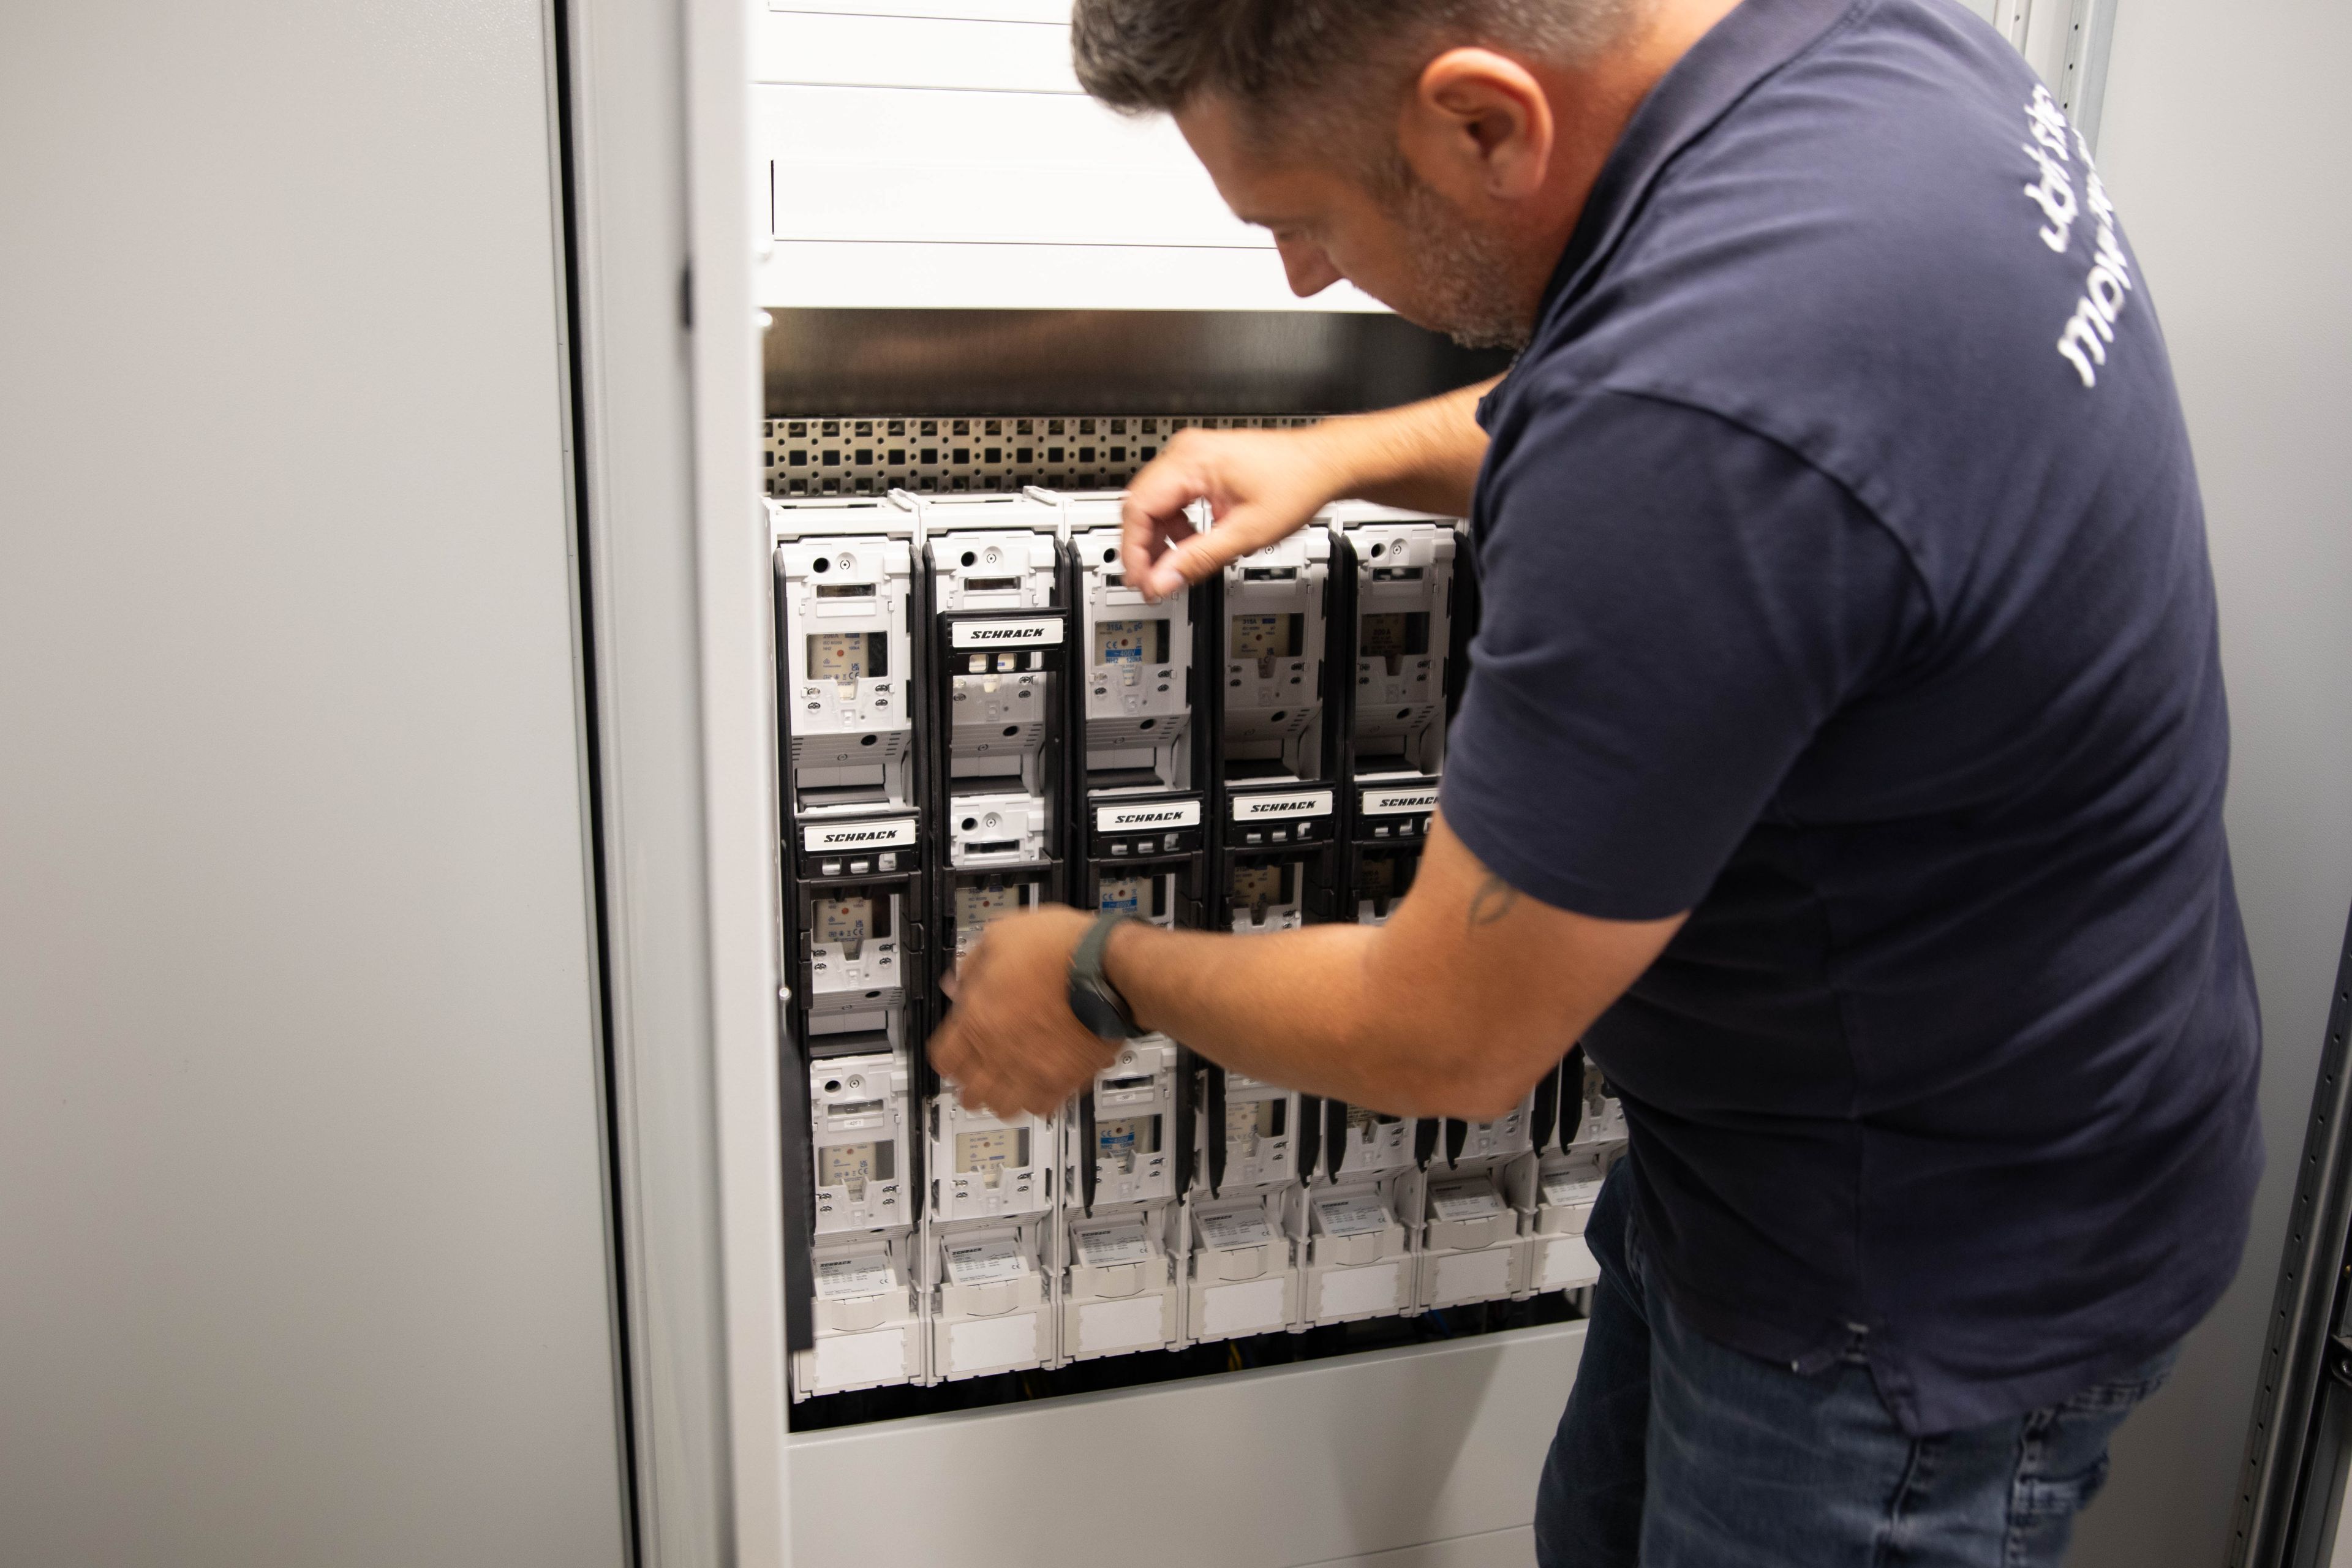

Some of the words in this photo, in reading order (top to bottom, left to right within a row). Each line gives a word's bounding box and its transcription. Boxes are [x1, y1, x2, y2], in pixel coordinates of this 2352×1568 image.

[970, 628, 1045, 639] SCHRACK
[1250, 801, 1316, 813] SCHRACK
[1115, 812, 1183, 823] SCHRACK
[823, 830, 897, 843] SCHRACK
